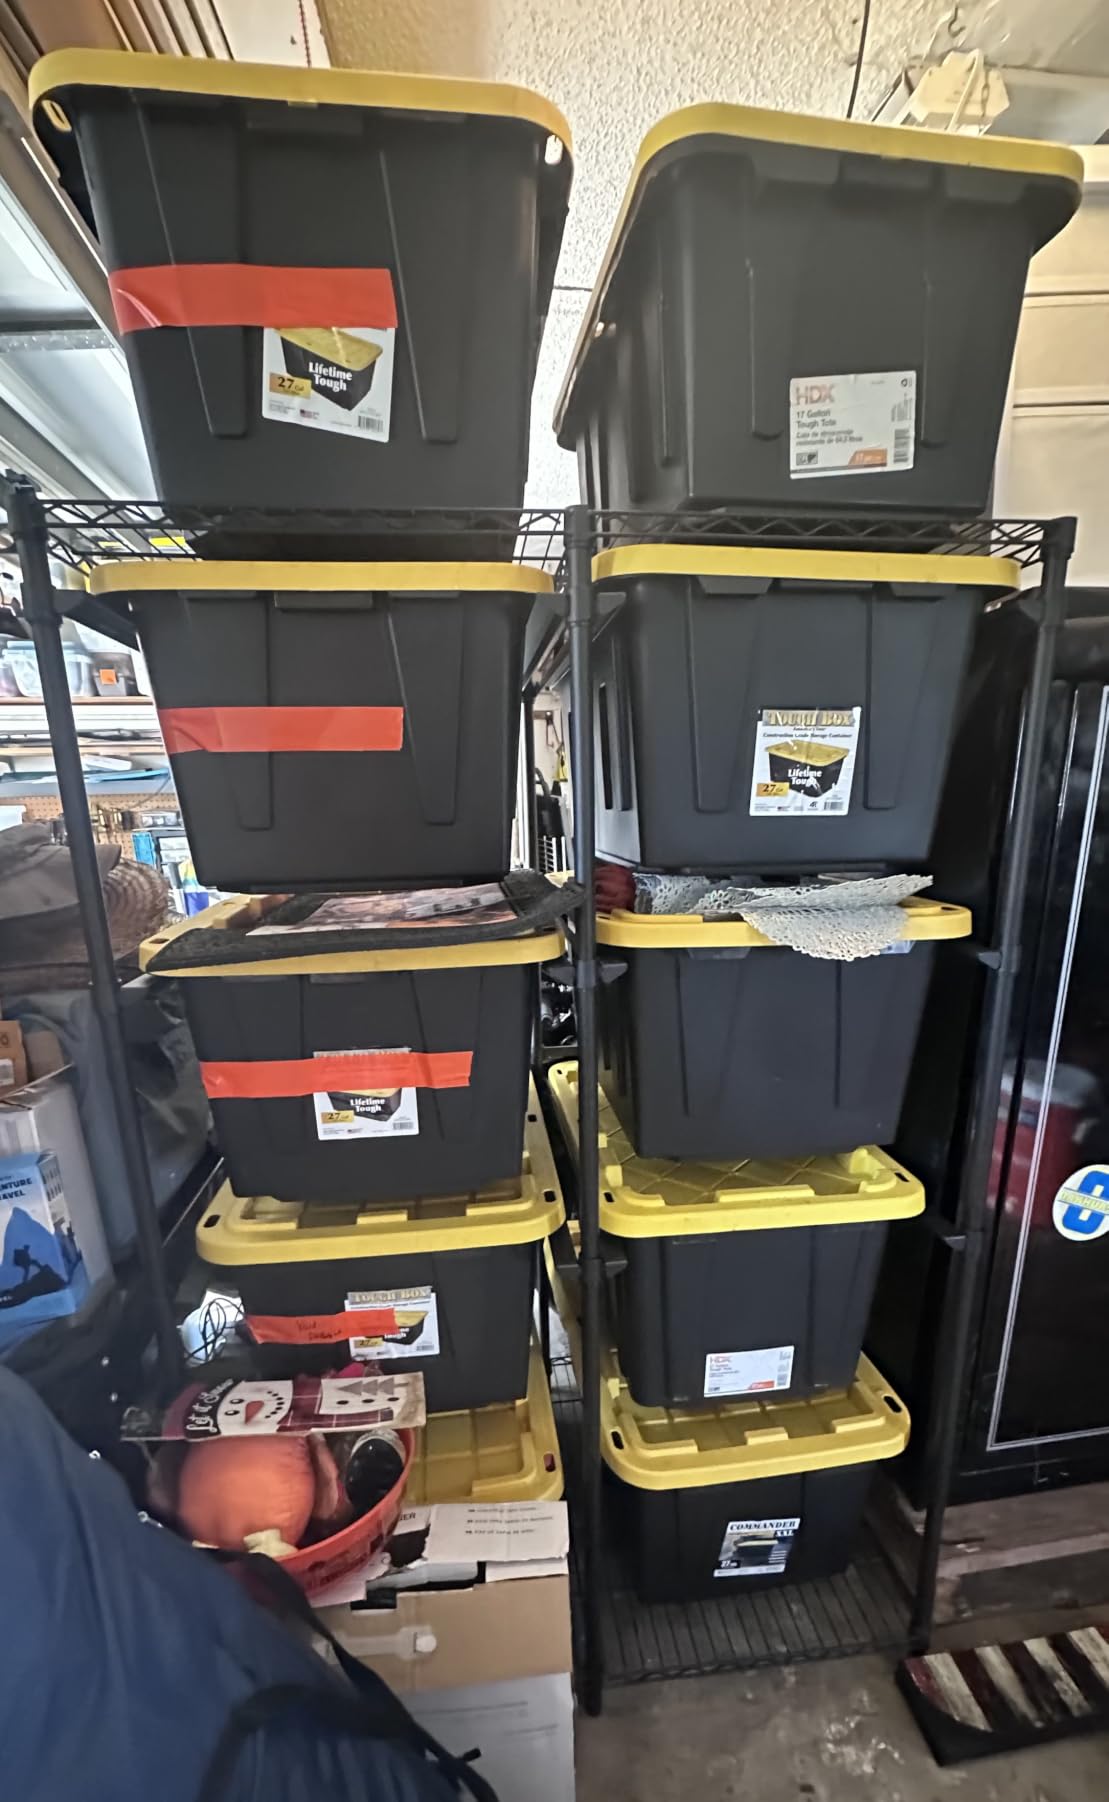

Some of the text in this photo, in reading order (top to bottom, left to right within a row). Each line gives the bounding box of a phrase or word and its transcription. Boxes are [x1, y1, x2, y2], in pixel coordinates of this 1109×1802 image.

[308, 362, 353, 381] Lifetime
[278, 376, 295, 390] 27
[314, 375, 347, 392] Tough
[796, 384, 835, 406] HDX
[807, 409, 831, 418] Gallon
[796, 419, 837, 430] Tough Tote
[787, 768, 823, 778] Lifetime
[762, 783, 776, 793] 27
[351, 1098, 385, 1106] Lifetime
[356, 1105, 382, 1113] Tough
[327, 1112, 341, 1121] 27
[0, 1189, 26, 1201] AVEL
[186, 1379, 233, 1432] Let it Snow
[730, 1521, 795, 1531] COMMANDER
